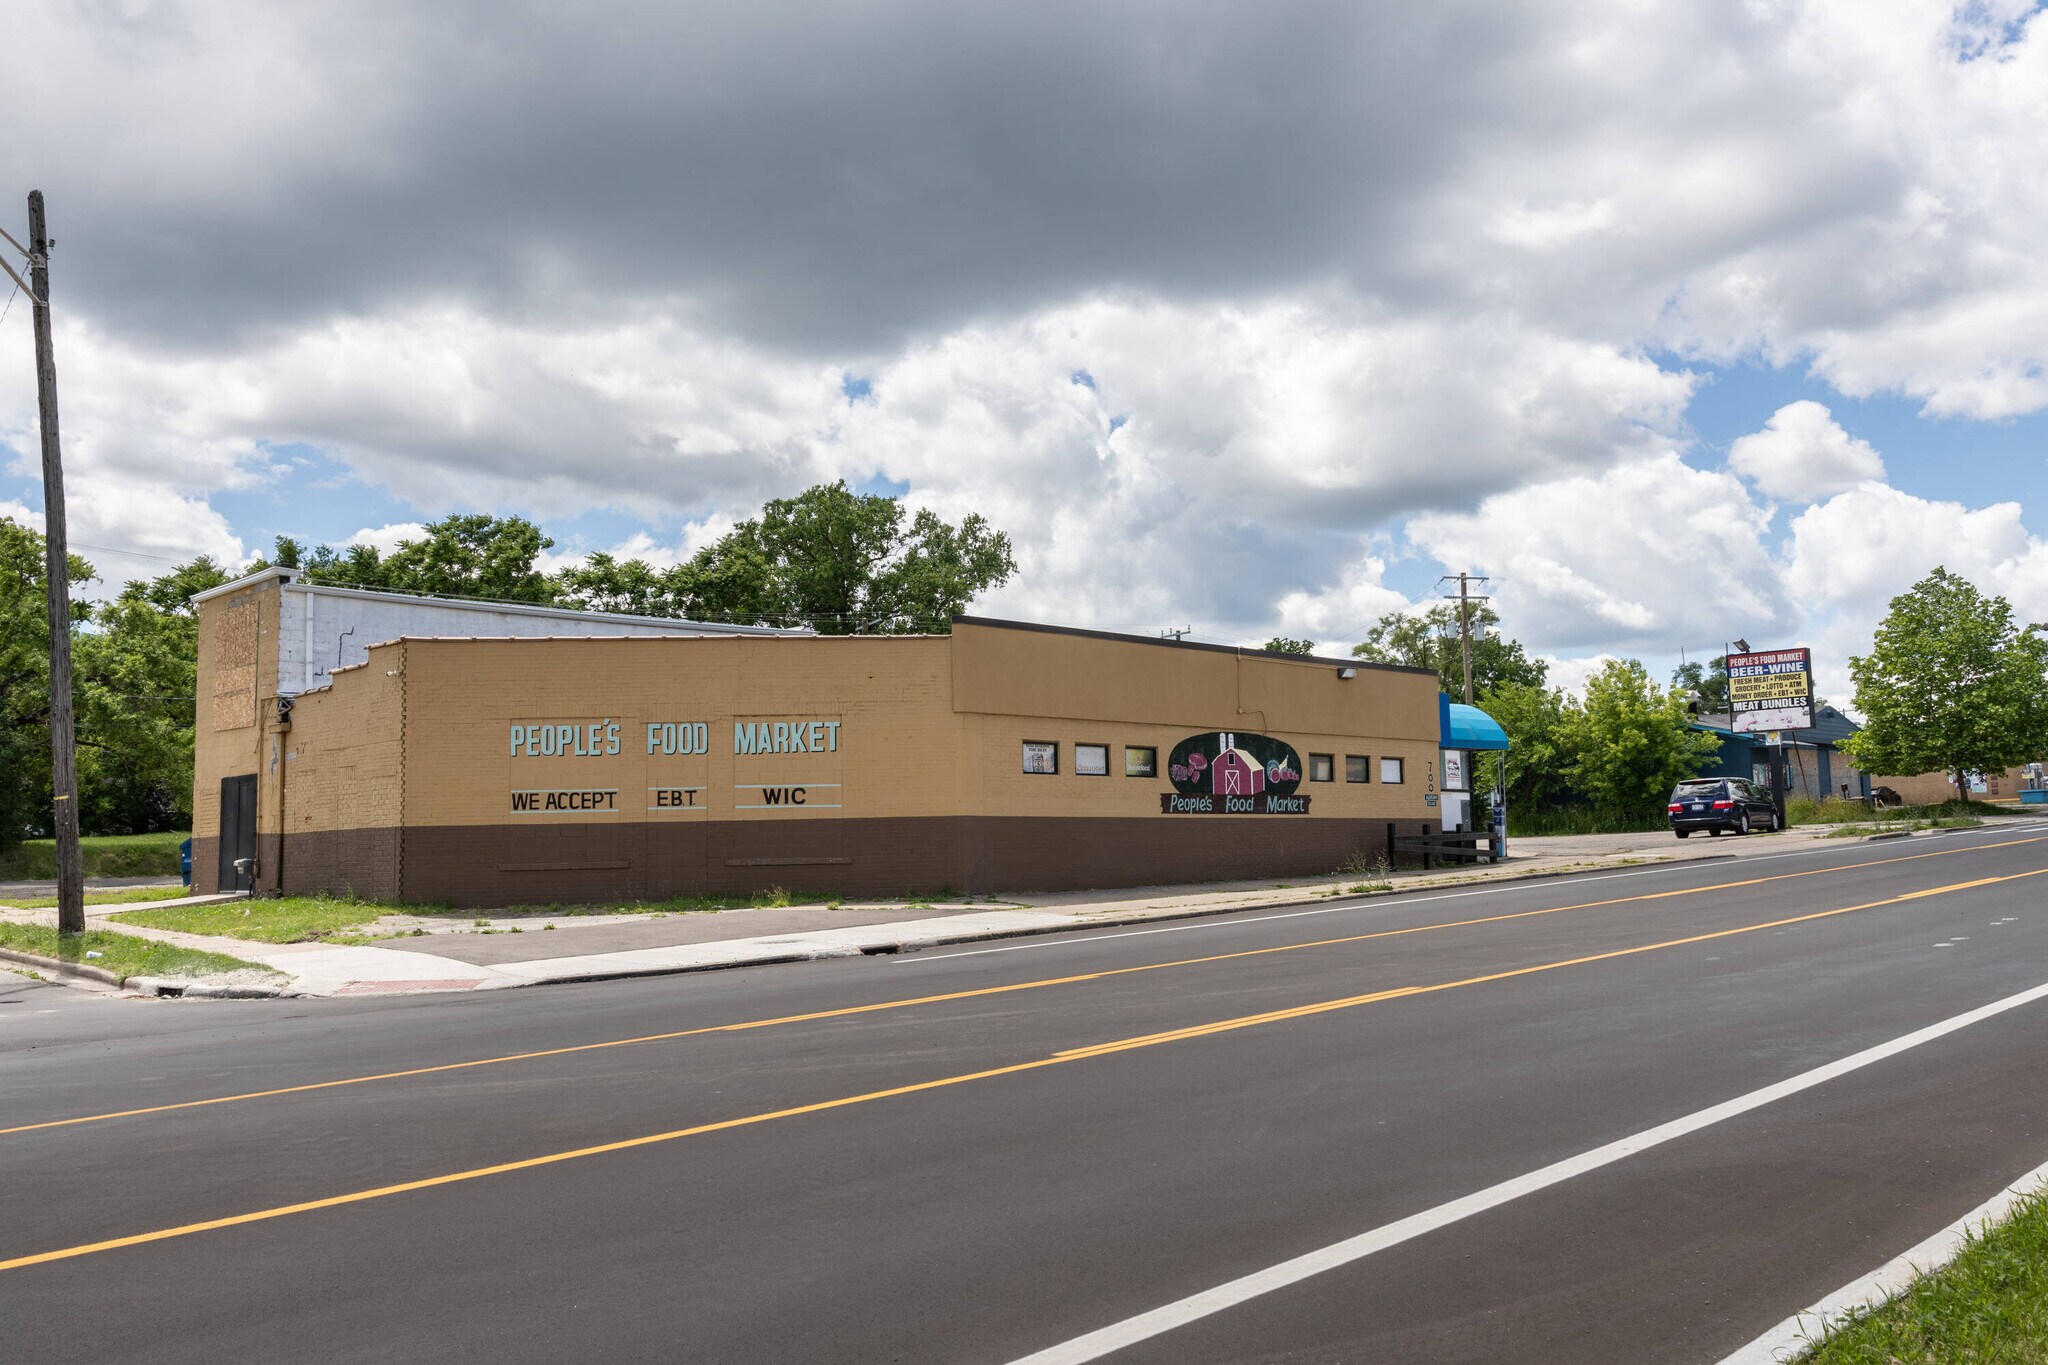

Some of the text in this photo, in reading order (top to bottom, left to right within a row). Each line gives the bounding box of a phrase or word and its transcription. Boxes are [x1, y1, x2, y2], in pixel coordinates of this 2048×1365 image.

[1730, 652, 1803, 667] PEOPLE'S FOOD MARKET
[1731, 662, 1804, 677] BEER-WINE
[1774, 673, 1802, 681] PRODUCE
[1732, 692, 1752, 700] MONEY
[1734, 697, 1806, 711] MEAT BUNDLES
[510, 718, 841, 757] PEOPLE'S FOOD MARKET
[511, 791, 617, 811] WE ACCEPT
[762, 787, 807, 805] WIC
[1170, 794, 1304, 814] People's Food Market
